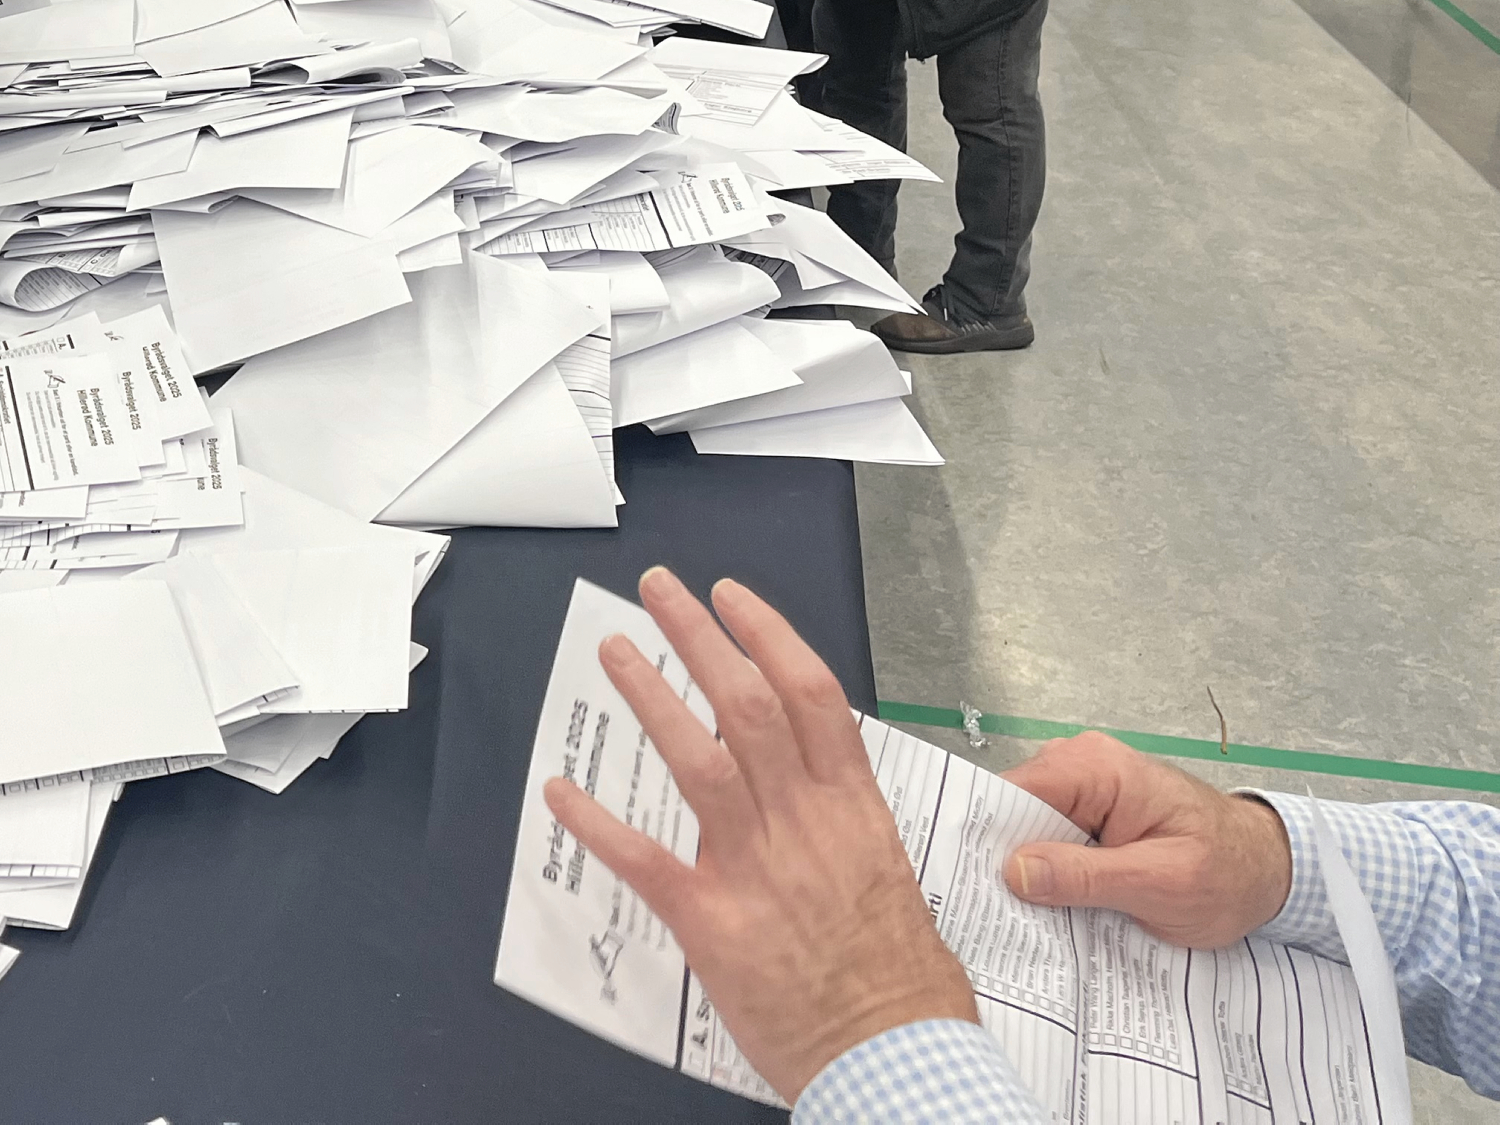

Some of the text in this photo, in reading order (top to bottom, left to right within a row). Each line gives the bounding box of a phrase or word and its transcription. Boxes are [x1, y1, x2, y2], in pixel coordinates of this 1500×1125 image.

[149, 370, 167, 402] Kommune
[151, 341, 182, 398] Byrådsvalget 2025
[89, 388, 114, 445] Byrådsvalget 2025
[121, 371, 141, 430] Byrådsvalget 2025
[84, 415, 98, 446] Kommune
[203, 438, 222, 489] Byrådsvalget 2025
[584, 712, 610, 796] ommune
[542, 698, 589, 883] Byrådget 2025
[1122, 1002, 1130, 1033] Christian
[1153, 1010, 1161, 1043] Flemming
